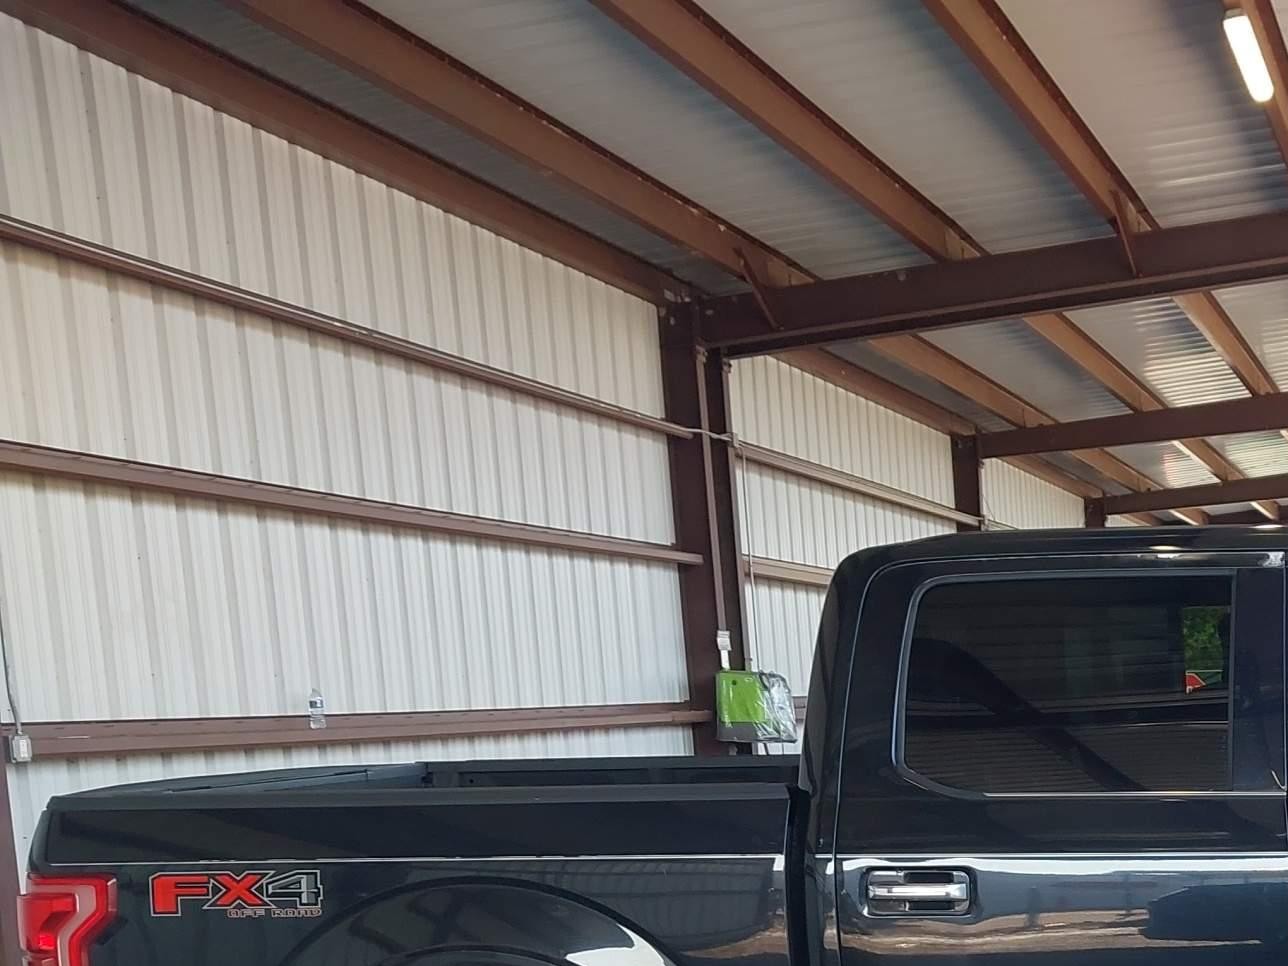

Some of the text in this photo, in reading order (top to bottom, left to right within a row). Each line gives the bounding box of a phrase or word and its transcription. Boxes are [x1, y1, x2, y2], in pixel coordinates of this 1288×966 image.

[149, 869, 323, 916] FX4
[227, 908, 322, 918] OFF ROAD
